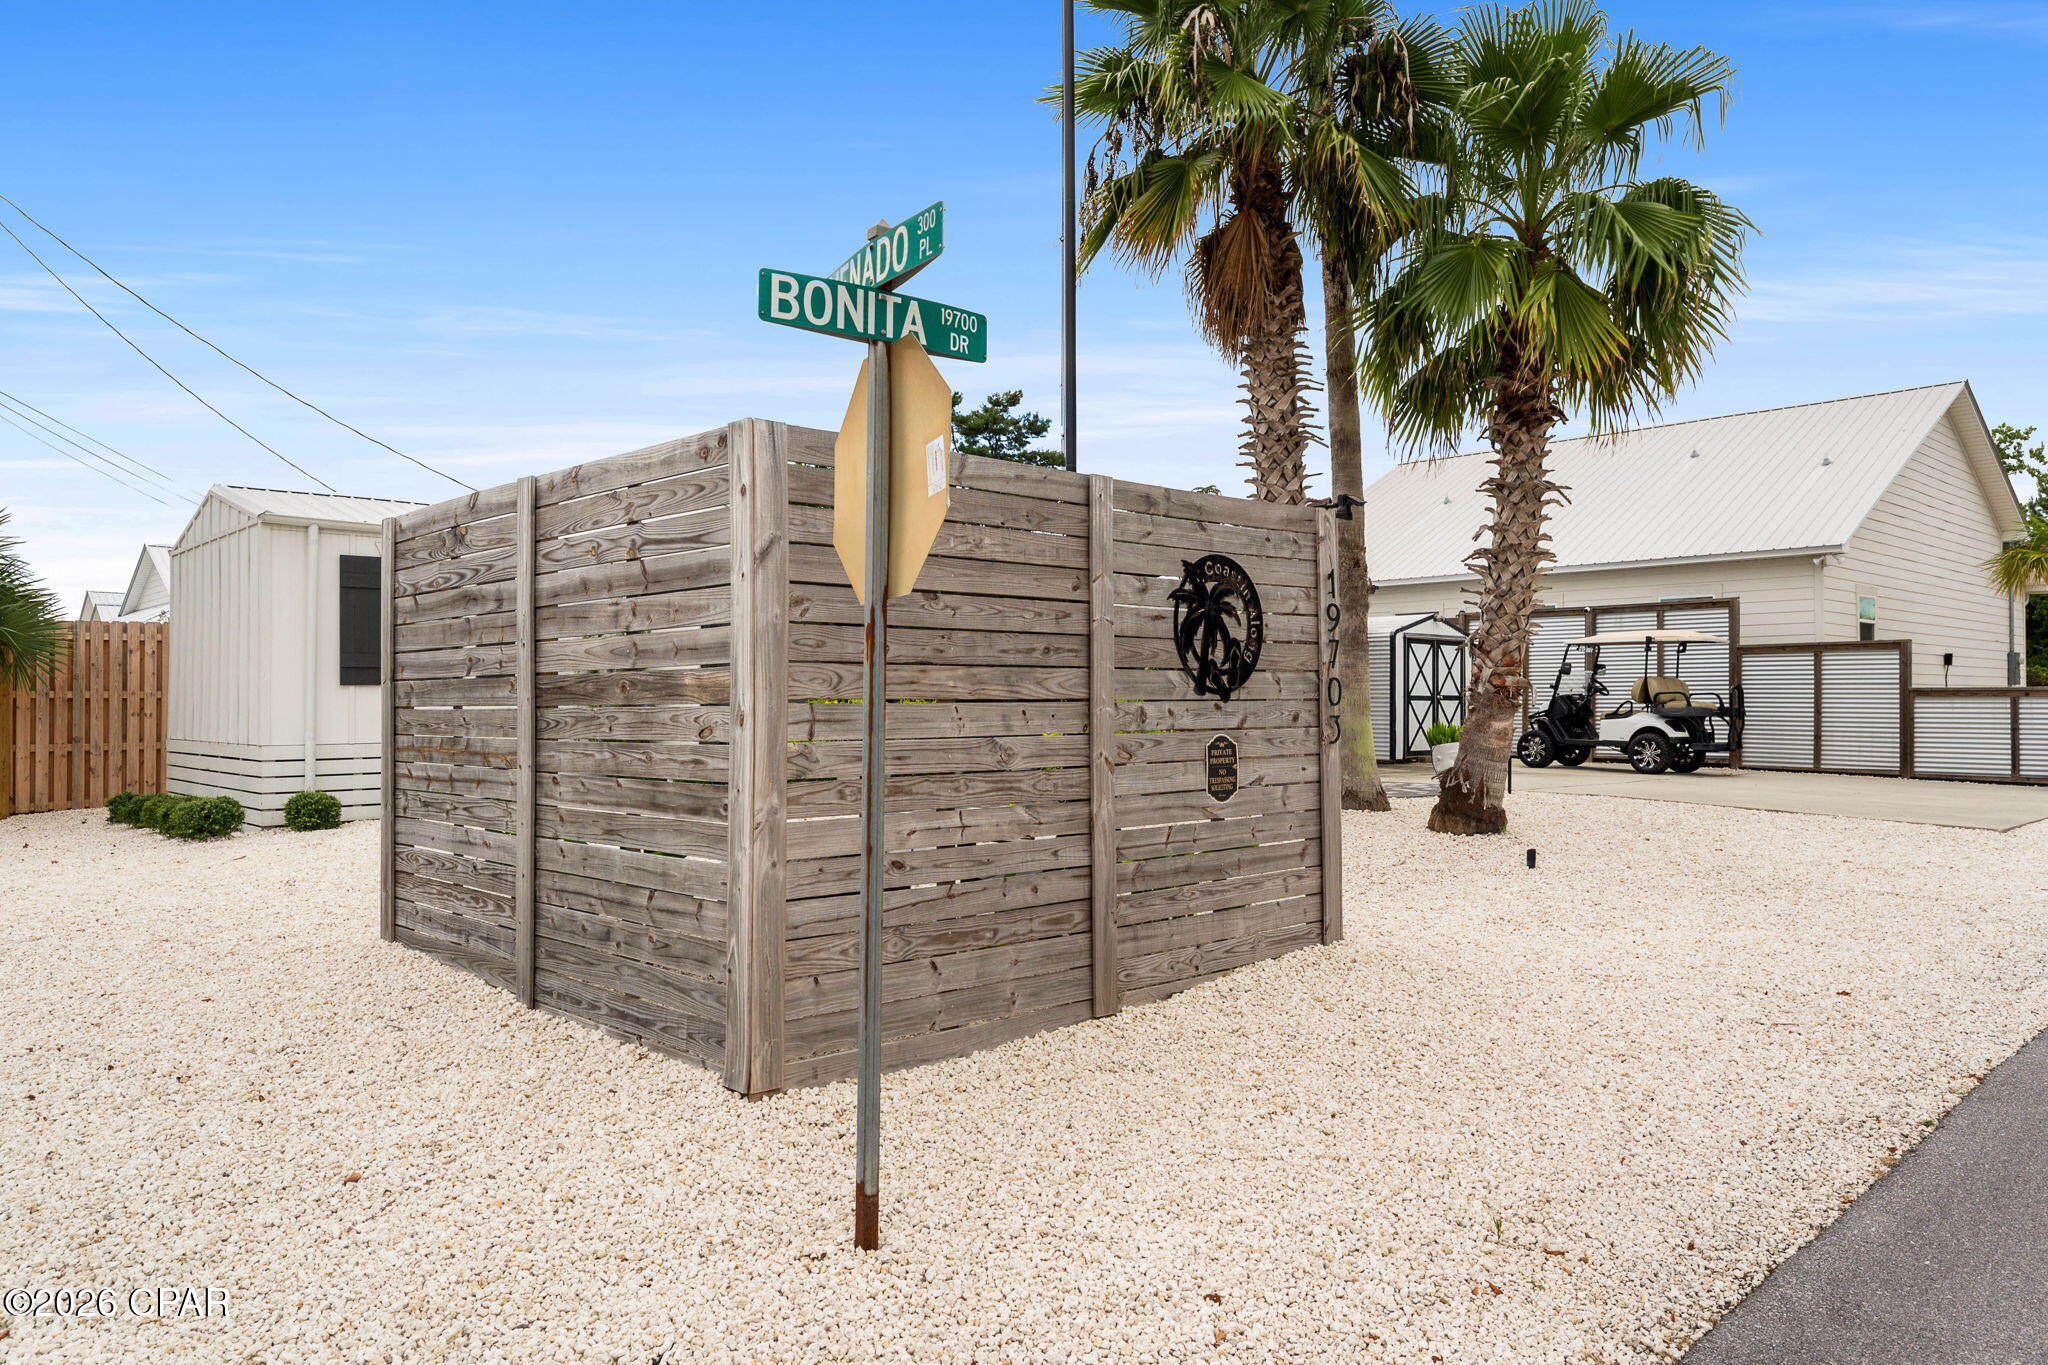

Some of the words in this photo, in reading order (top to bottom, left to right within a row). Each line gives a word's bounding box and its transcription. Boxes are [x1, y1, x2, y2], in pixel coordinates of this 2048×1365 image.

[917, 209, 936, 235] 300
[829, 225, 909, 288] NADO
[919, 236, 933, 260] PL
[771, 273, 927, 345] BONITA
[940, 308, 978, 333] 19700
[949, 333, 969, 354] DR
[1326, 568, 1342, 745] 19703
[1209, 776, 1236, 784] TRESPASSING
